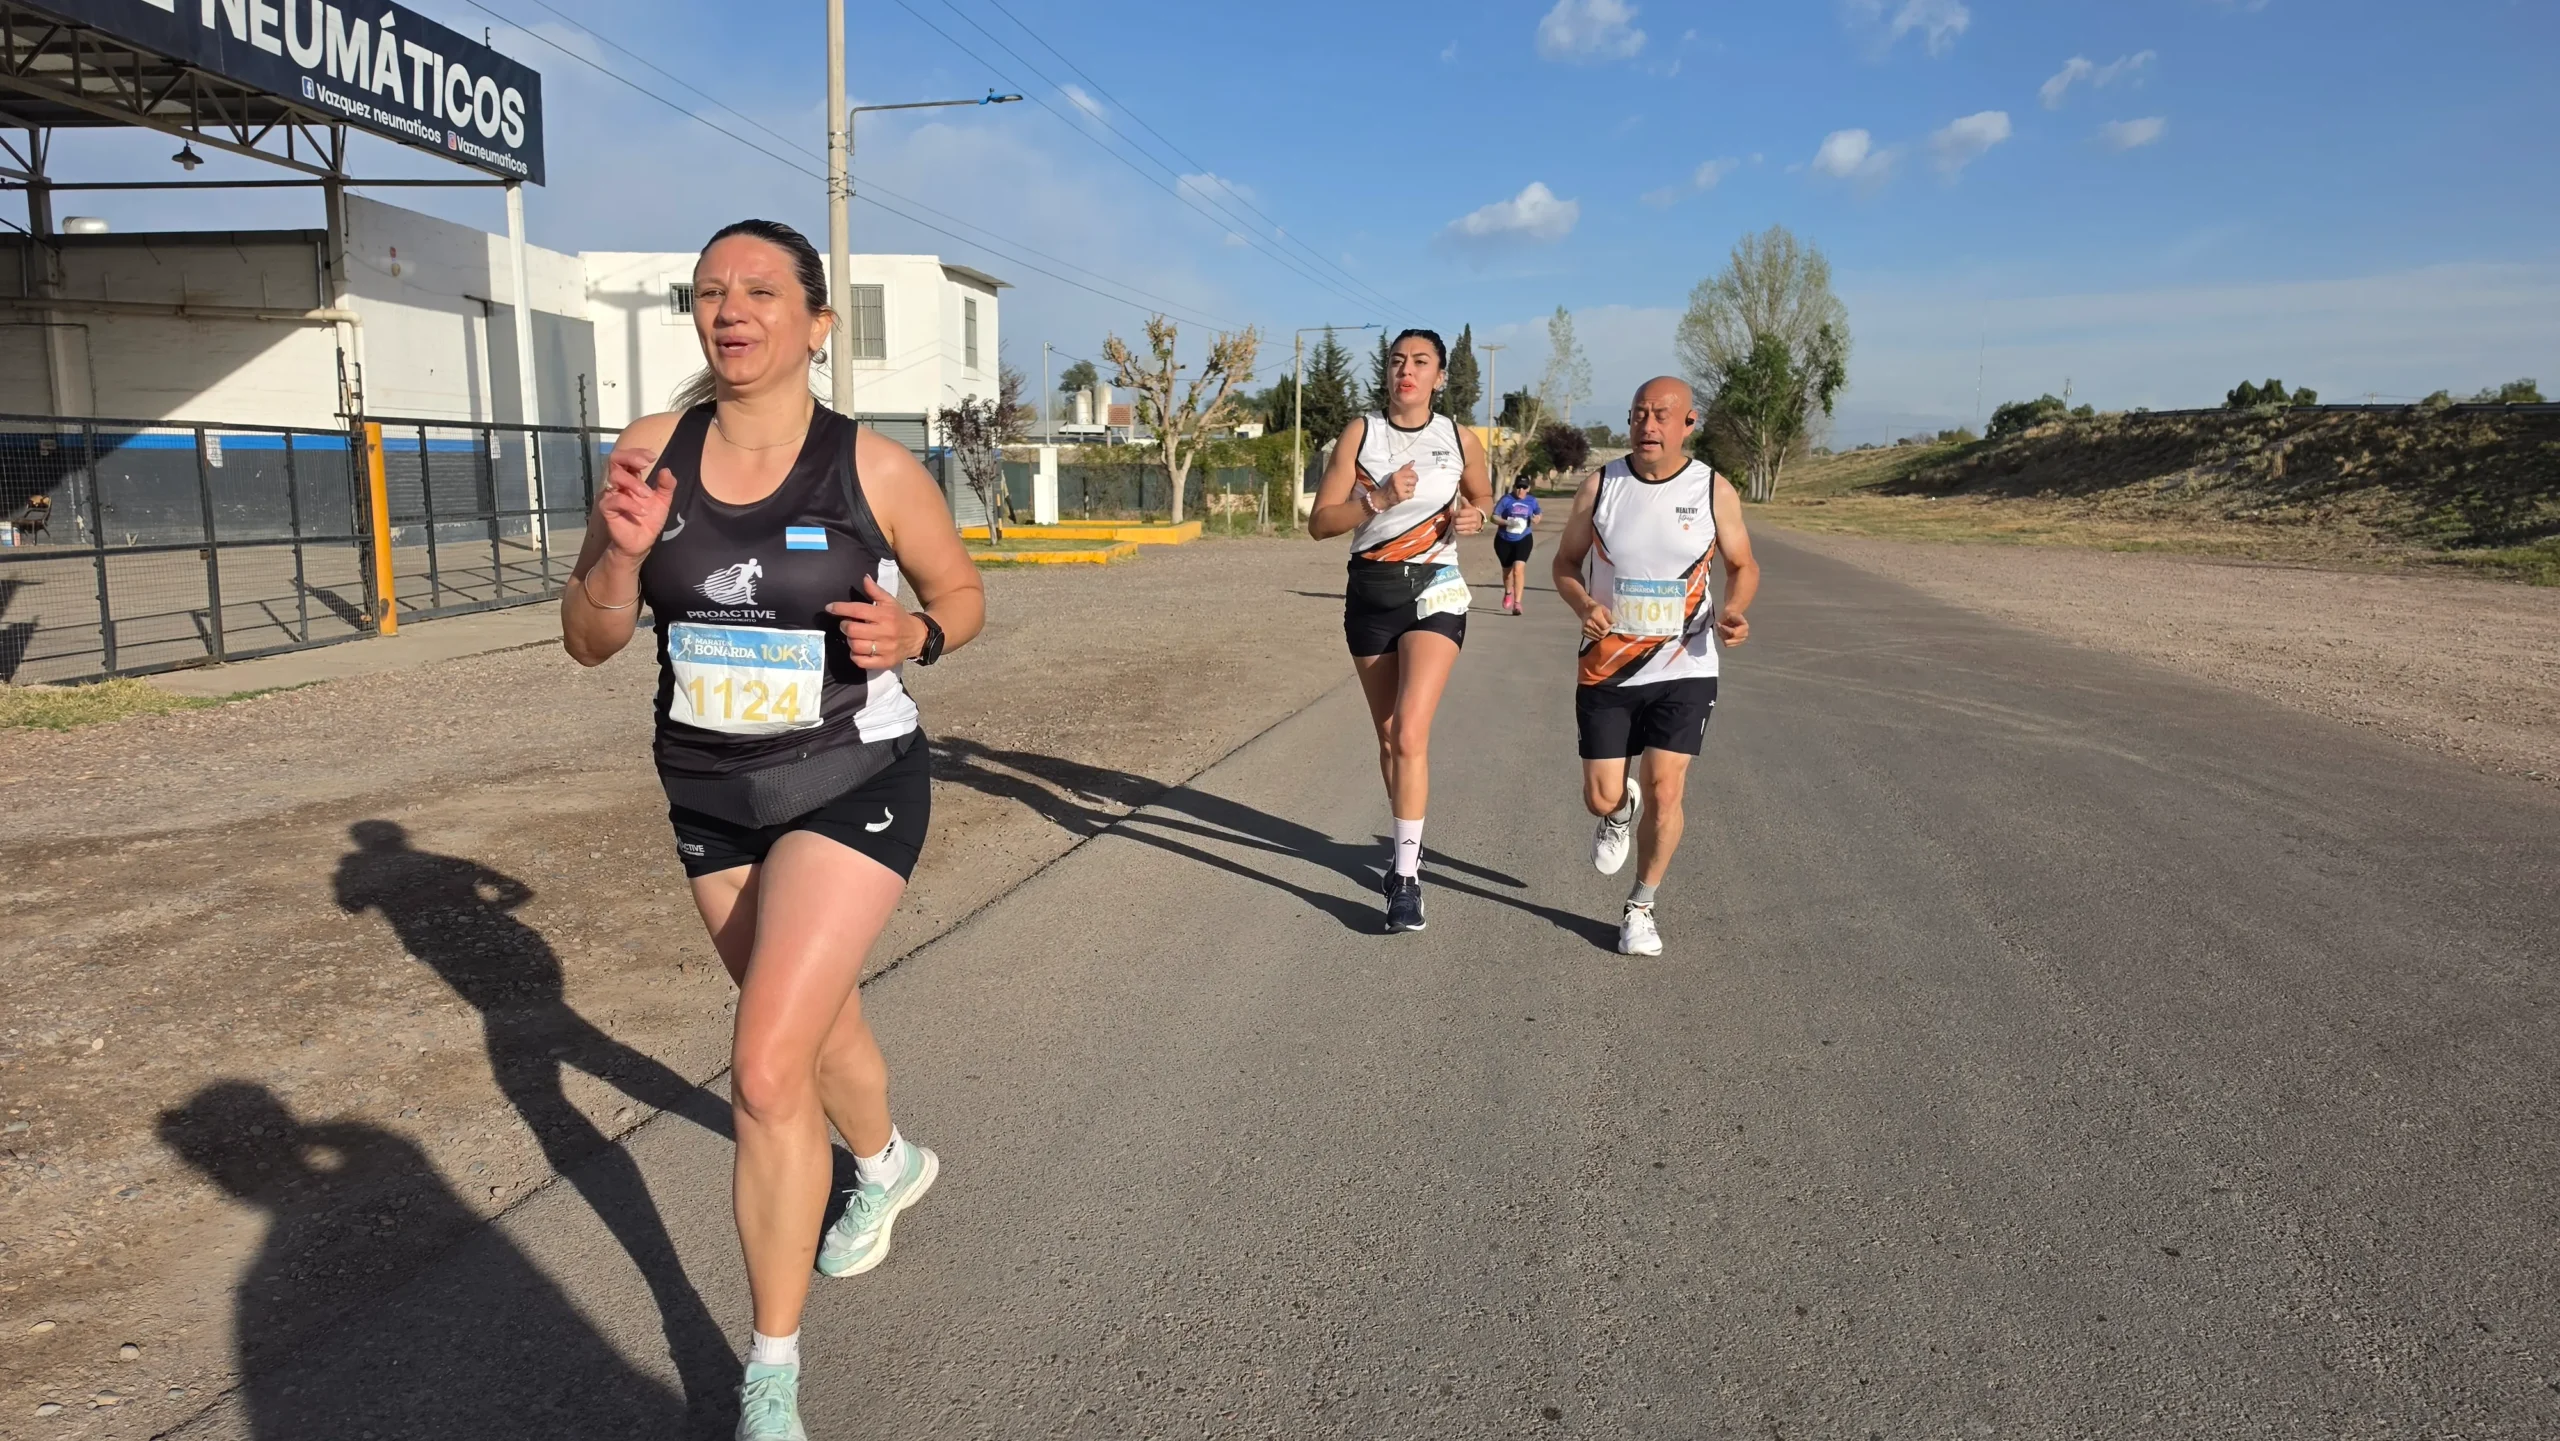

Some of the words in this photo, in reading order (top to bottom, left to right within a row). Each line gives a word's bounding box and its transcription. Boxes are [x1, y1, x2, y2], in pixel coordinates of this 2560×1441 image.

[316, 83, 371, 118] Vazquez
[373, 108, 442, 144] neumaticos
[456, 135, 528, 175] Vazneumaticos
[686, 609, 776, 619] PROACTIVE
[1622, 601, 1673, 622] 1101
[694, 644, 757, 659] BONARDA
[761, 643, 799, 662] 10K
[687, 675, 801, 725] 1124
